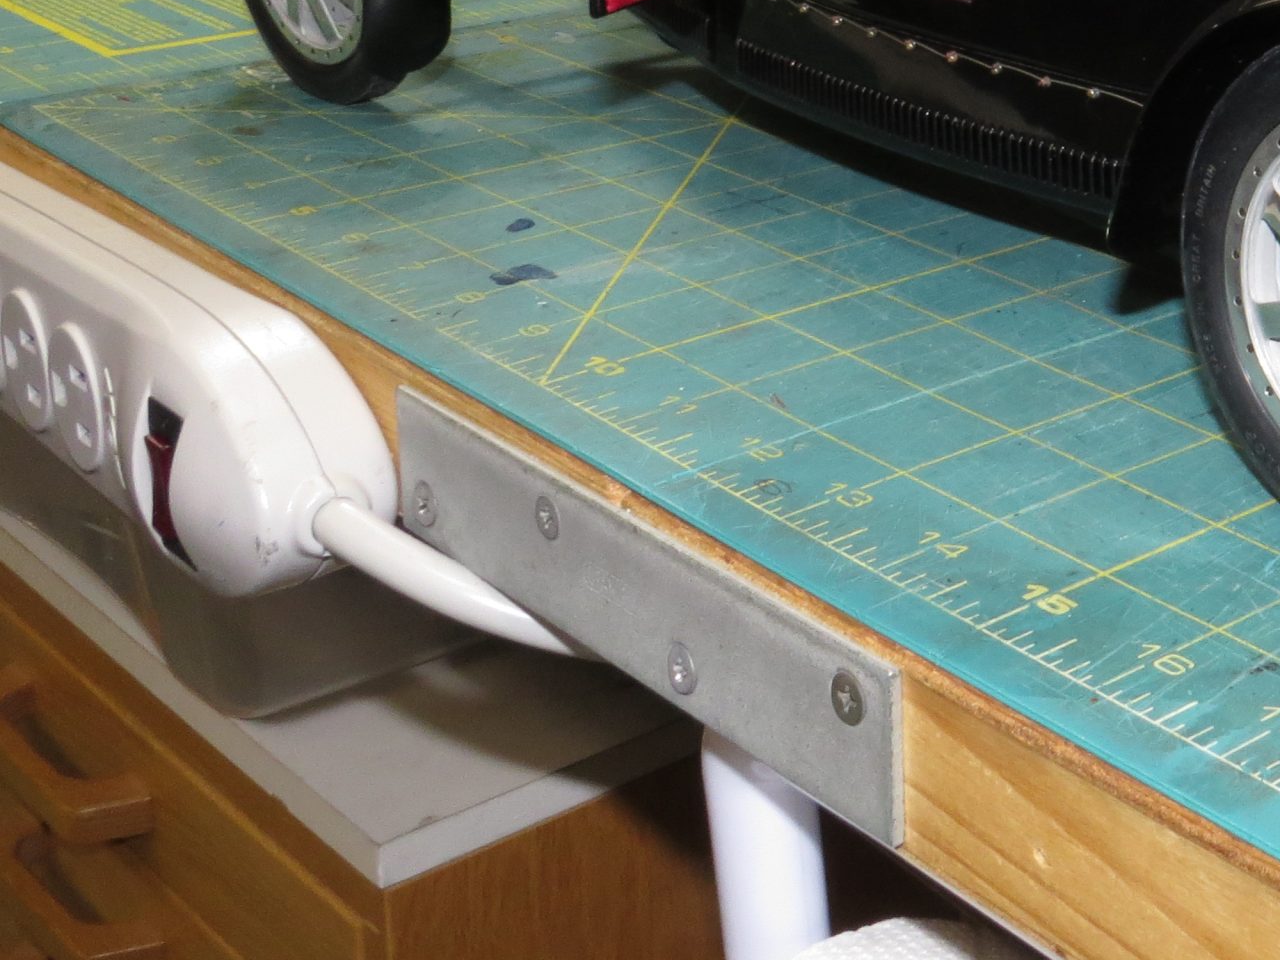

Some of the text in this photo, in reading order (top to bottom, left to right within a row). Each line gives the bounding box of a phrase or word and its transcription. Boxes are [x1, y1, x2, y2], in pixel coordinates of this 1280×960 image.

[582, 355, 626, 377] 10
[743, 436, 784, 461] 12
[823, 481, 875, 508] 13
[917, 530, 969, 560] 14
[1019, 583, 1078, 616] 15
[1133, 643, 1195, 676] 16
